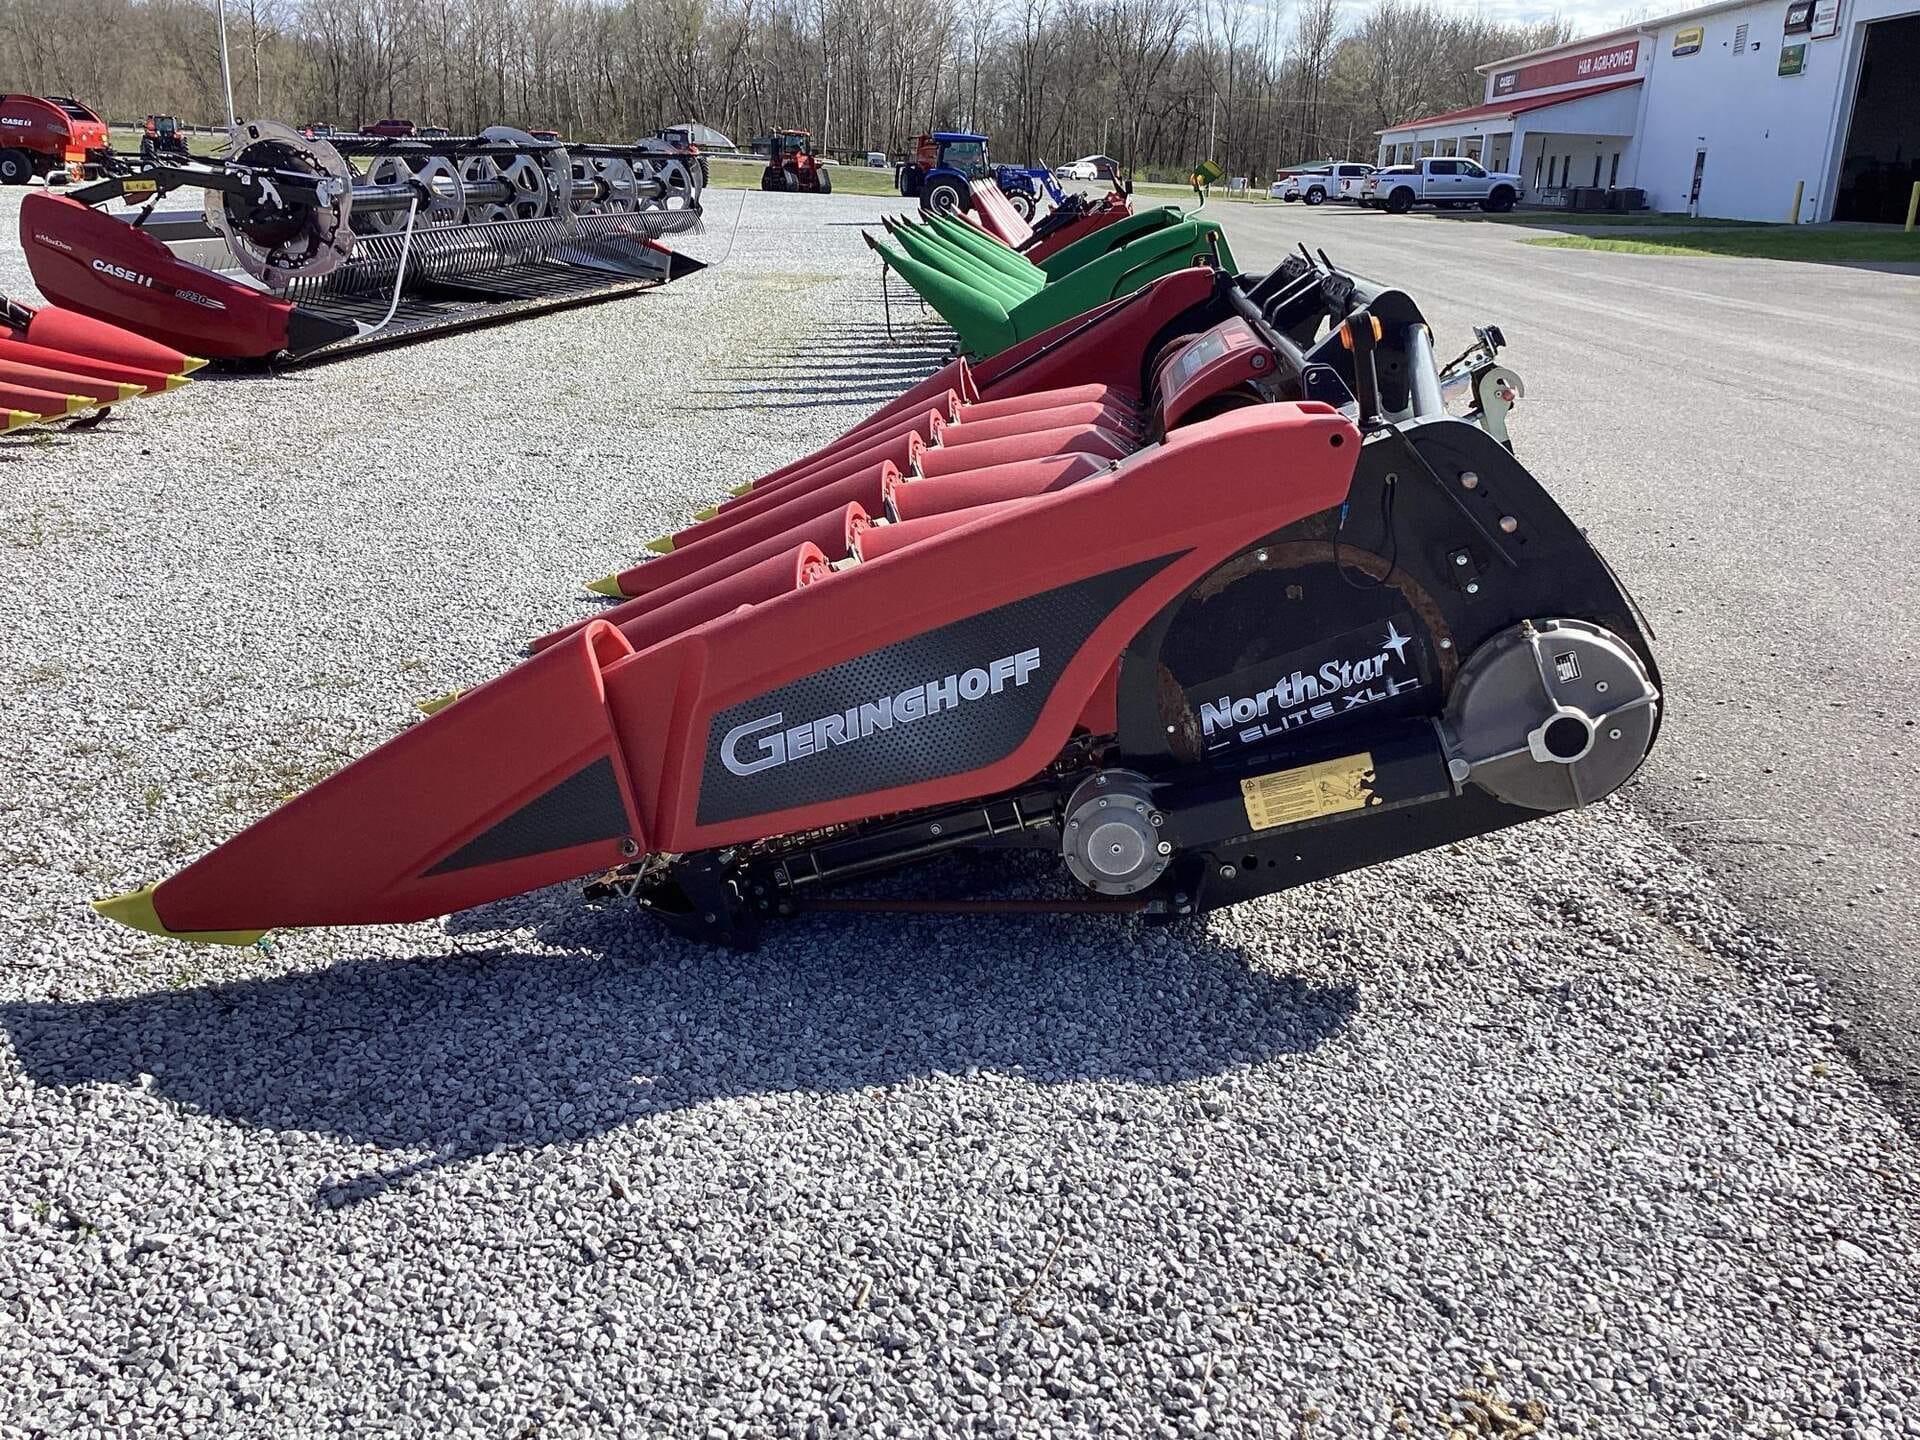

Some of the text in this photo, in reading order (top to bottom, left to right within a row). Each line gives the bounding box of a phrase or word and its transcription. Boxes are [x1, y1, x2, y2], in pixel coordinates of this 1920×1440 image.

[1592, 49, 1634, 71] AGRI-POWER
[1, 117, 24, 126] CASE
[92, 259, 137, 282] CASE
[1199, 652, 1389, 736] NorthStar
[720, 647, 1041, 777] GERINGHOFF
[1238, 701, 1335, 744] ELITE
